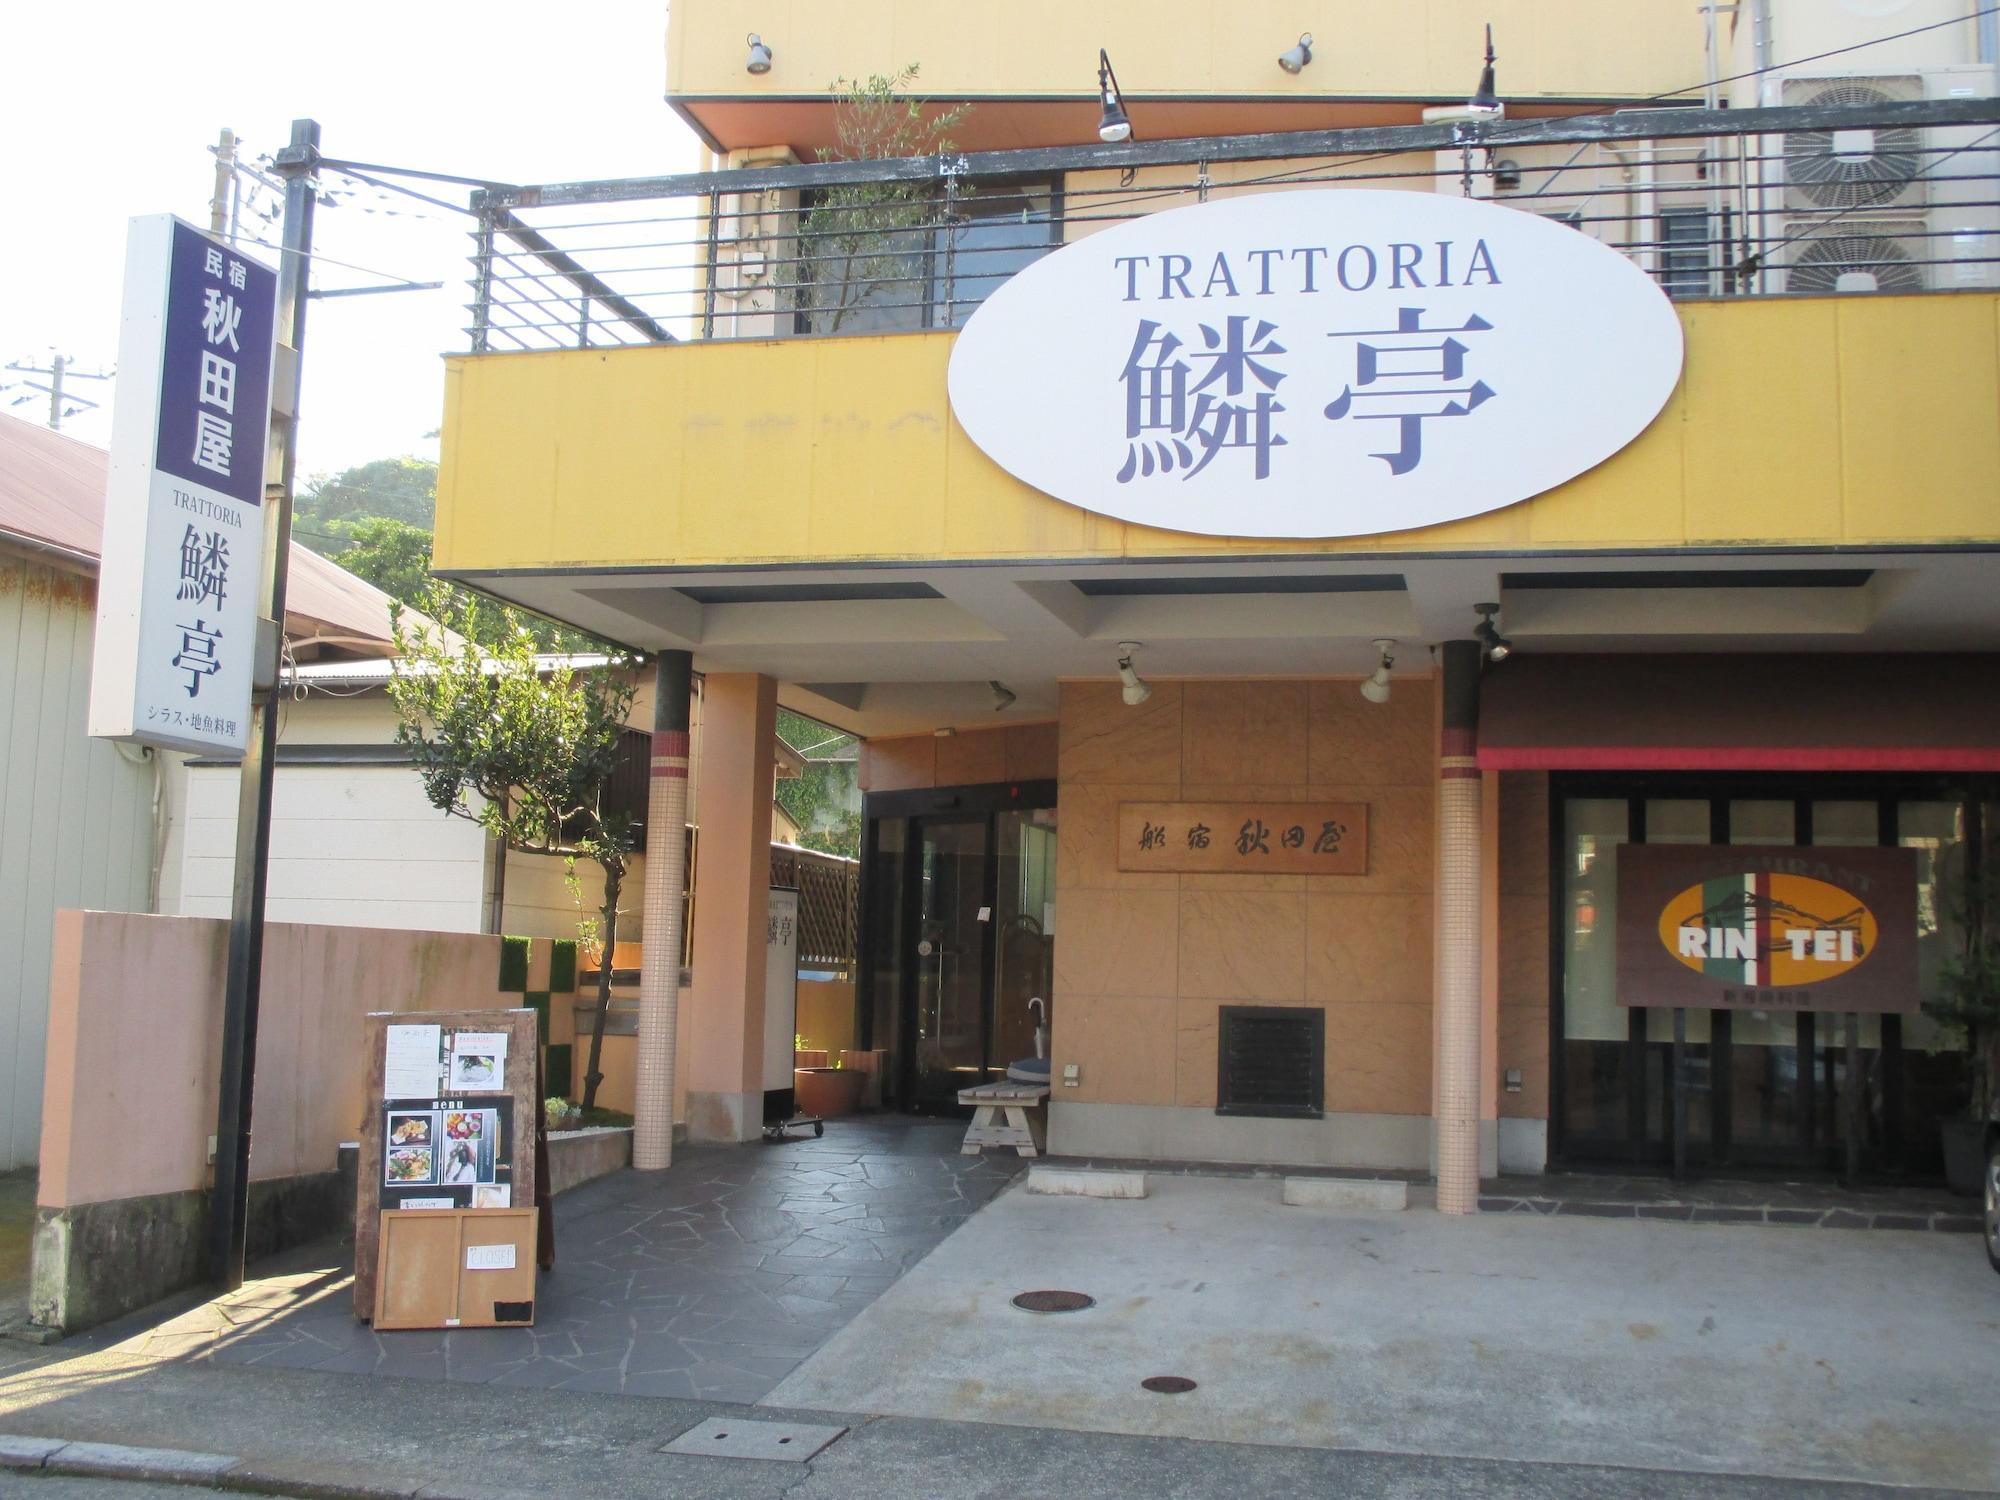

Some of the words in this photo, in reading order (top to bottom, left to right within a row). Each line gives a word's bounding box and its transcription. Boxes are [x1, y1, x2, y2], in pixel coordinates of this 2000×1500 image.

[204, 247, 247, 290] 民宿
[1115, 239, 1502, 302] TRATTORIA
[192, 287, 242, 477] 秋田屋
[1116, 307, 1498, 484] 鱗亭
[173, 489, 242, 528] TRATTORIA
[172, 523, 230, 698] 鱗亭
[1678, 926, 1758, 959] RIN
[1785, 929, 1854, 962] TEI
[432, 1100, 464, 1110] menu
